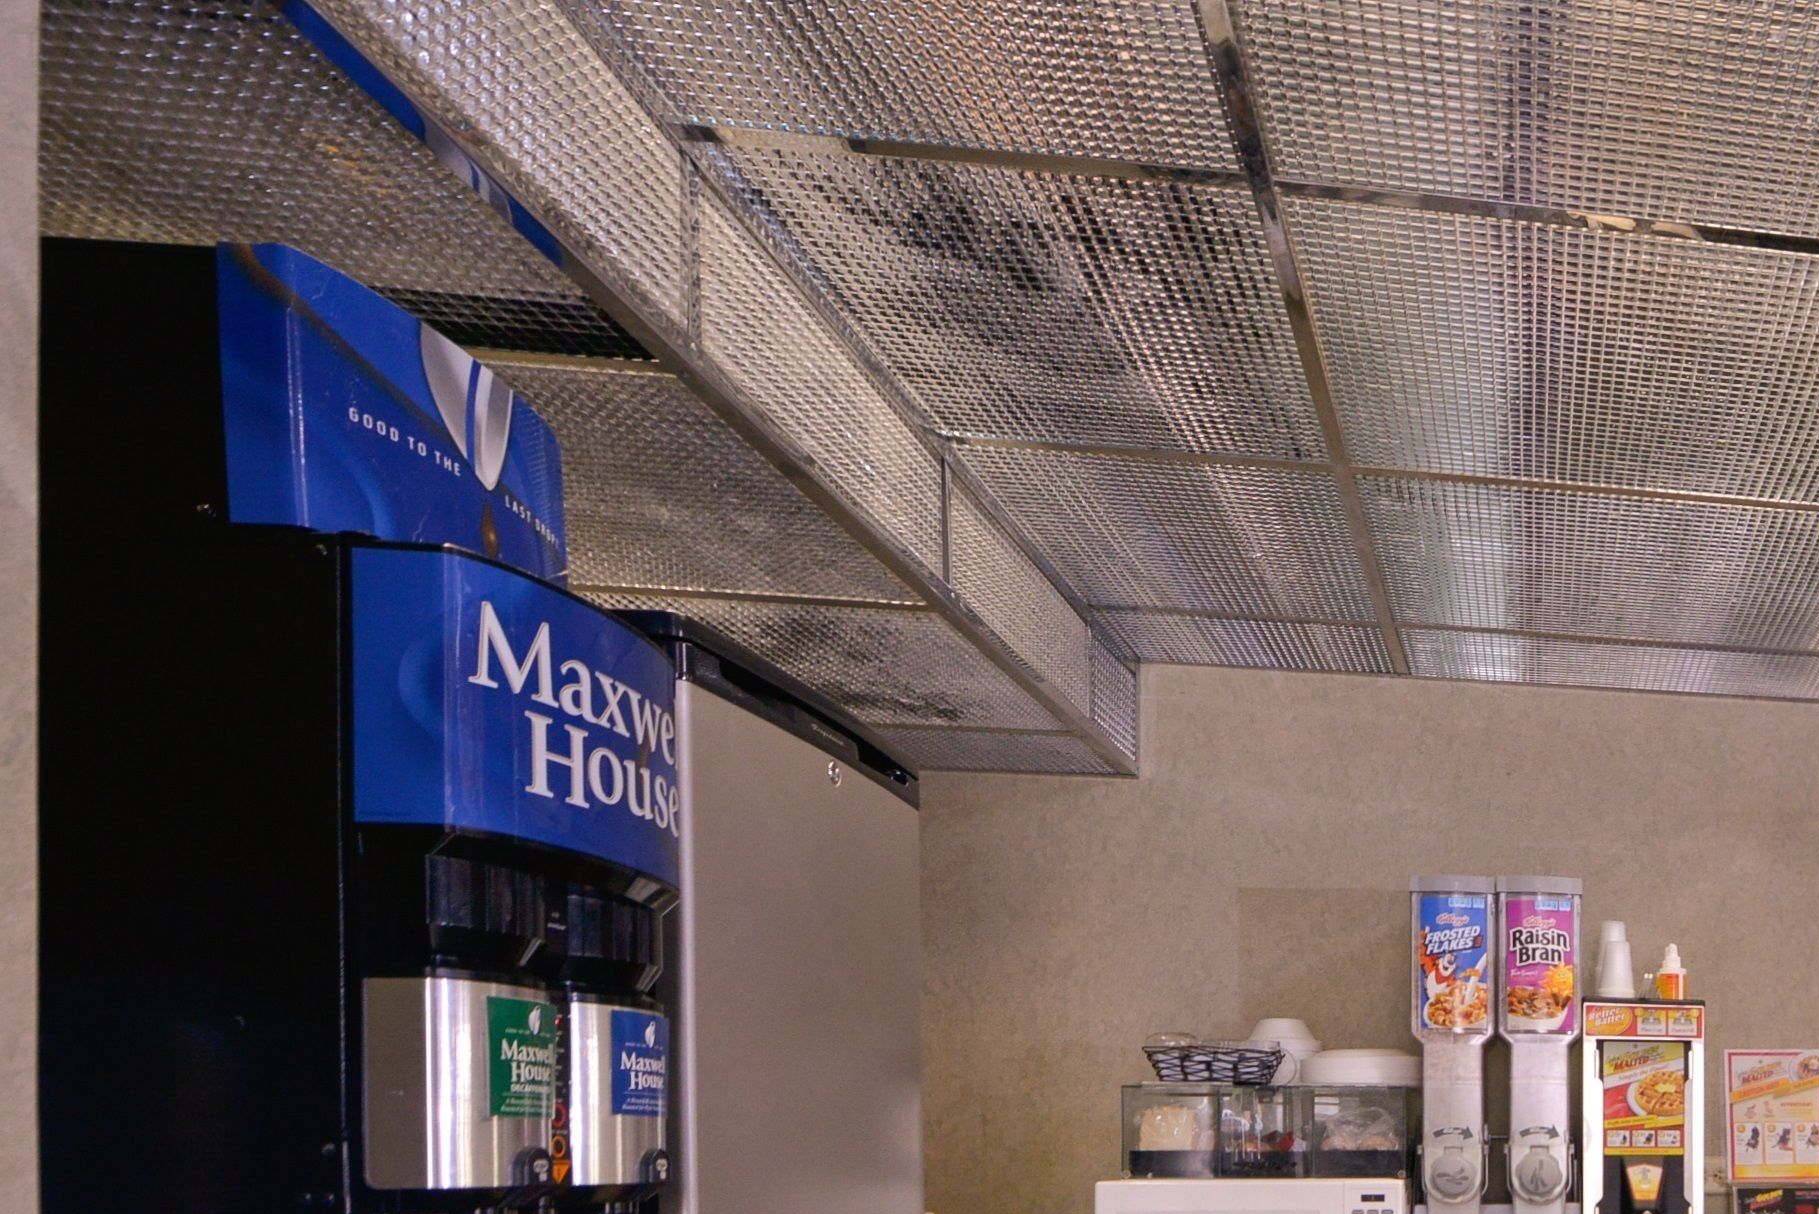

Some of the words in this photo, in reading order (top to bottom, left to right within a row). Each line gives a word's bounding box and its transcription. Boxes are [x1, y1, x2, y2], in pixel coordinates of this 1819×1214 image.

[349, 407, 399, 442] GOOD
[407, 436, 427, 456] TO
[434, 451, 461, 477] THE
[505, 495, 531, 522] LAST
[468, 600, 677, 770] Maxwe
[524, 710, 680, 838] House
[1425, 925, 1480, 945] FROSTED
[1511, 928, 1569, 949] Raisin
[1426, 936, 1474, 956] FLAKES
[1518, 945, 1563, 965] Bran
